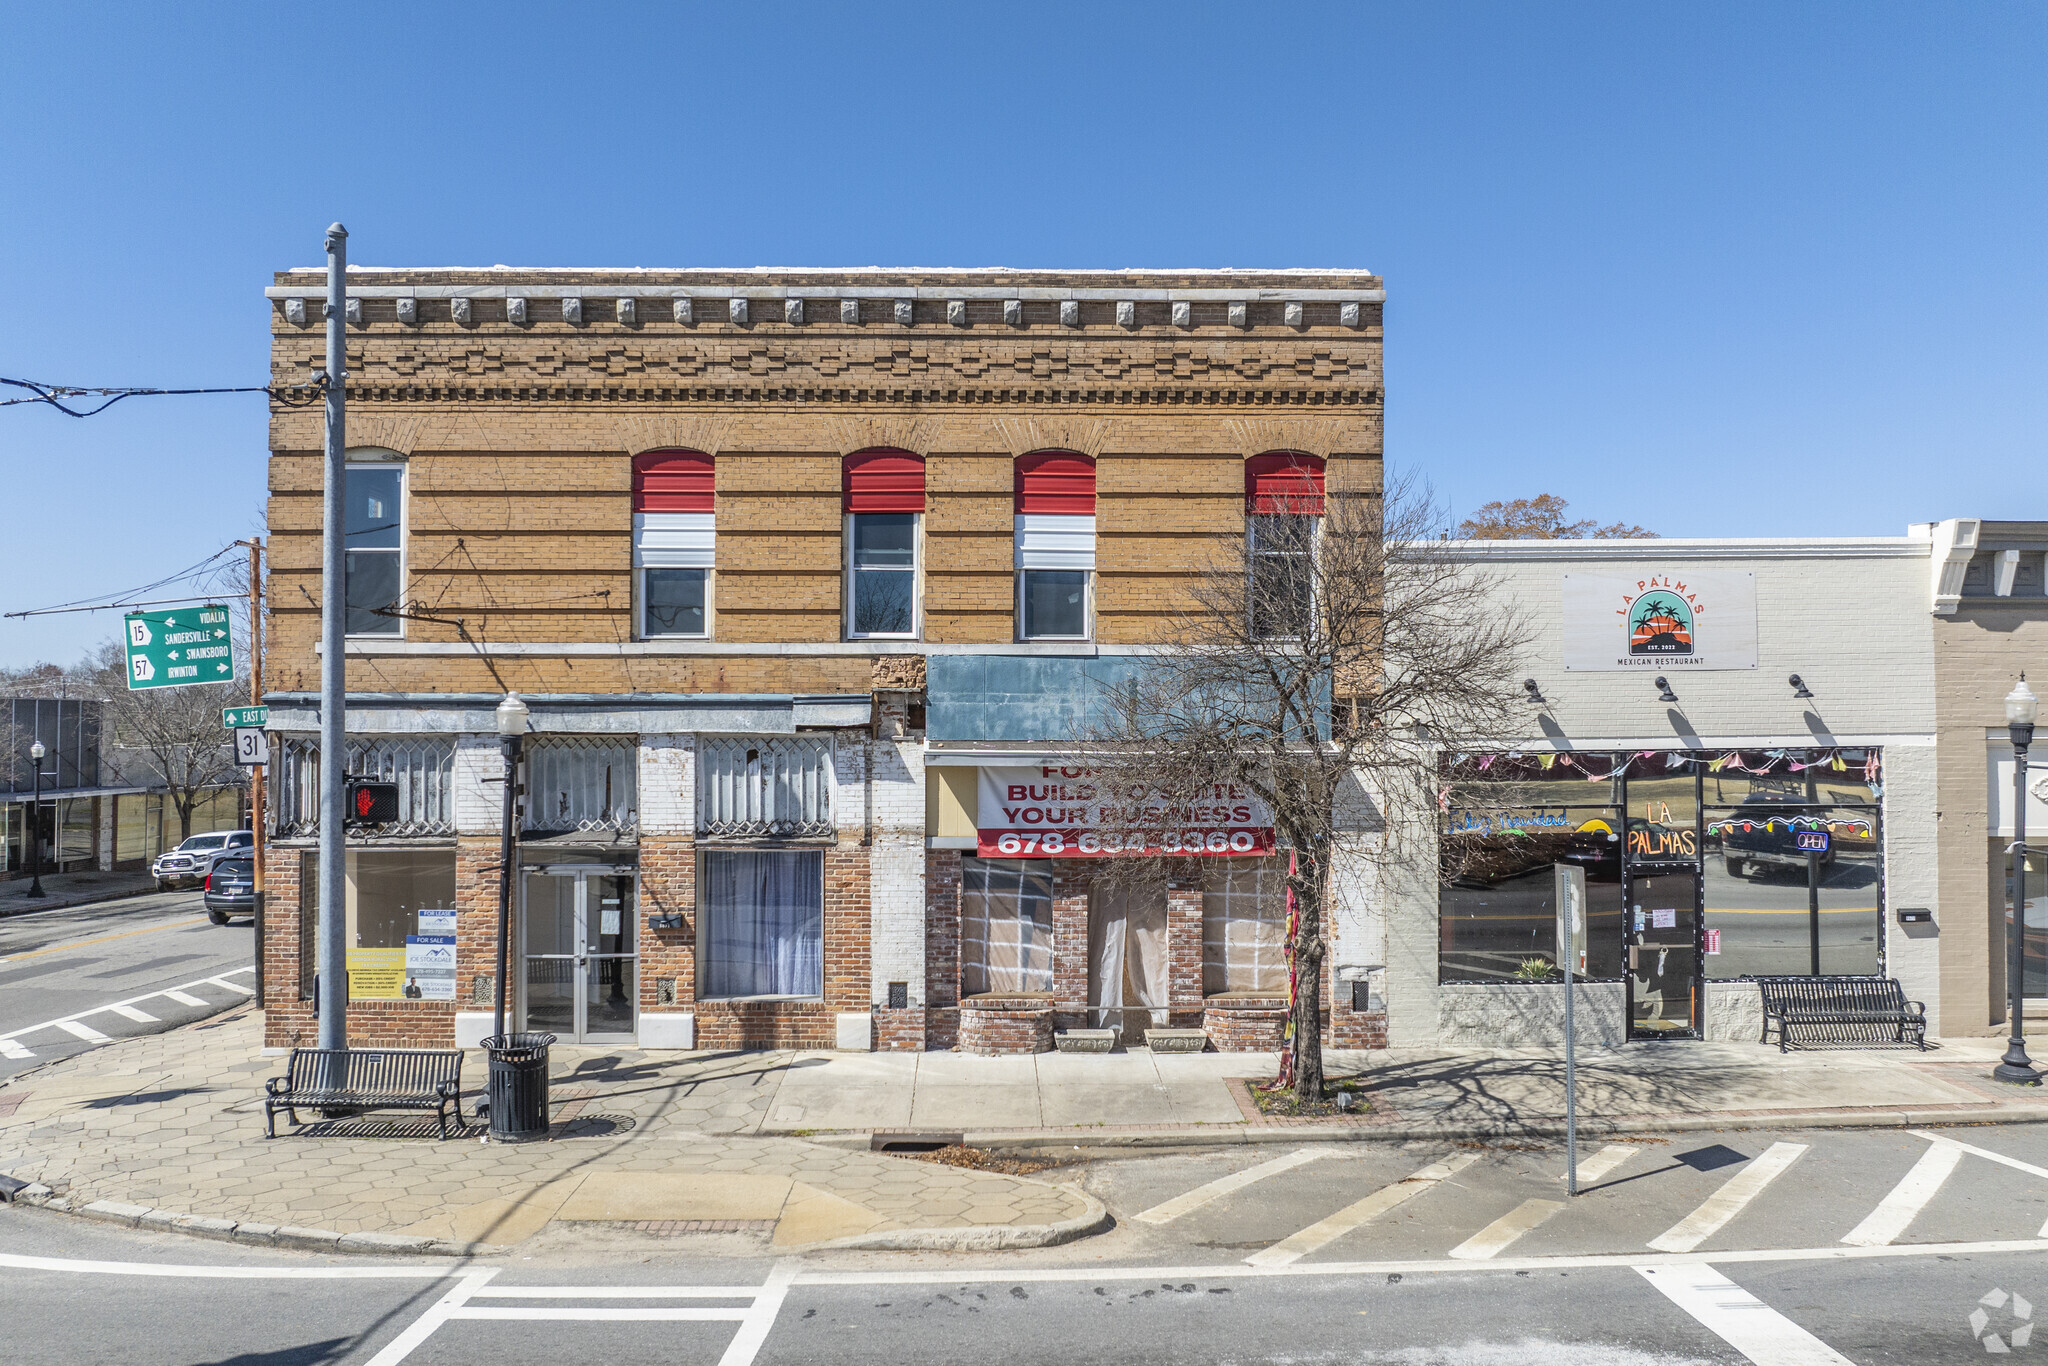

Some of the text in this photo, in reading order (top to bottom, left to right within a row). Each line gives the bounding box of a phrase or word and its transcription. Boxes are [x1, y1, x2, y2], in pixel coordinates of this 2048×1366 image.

[1616, 576, 1705, 616] LA PALMAS
[199, 611, 226, 625] VIDALIA
[133, 625, 144, 642] 15
[165, 630, 211, 646] SANDERSVILLE
[186, 645, 229, 660] SWAINSBORO
[135, 660, 147, 677] 57
[1617, 657, 1704, 666] MEXICAN RESTAURANT
[167, 665, 198, 679] IRWINTON
[242, 710, 259, 723] EAST
[243, 735, 258, 756] 31
[1008, 784, 1096, 801] BUILD
[1002, 807, 1088, 824] YOUR
[1496, 808, 1572, 829] Navidad
[1647, 801, 1673, 824] LA
[1627, 830, 1696, 856] PALMAS
[1797, 834, 1827, 849] OPEN
